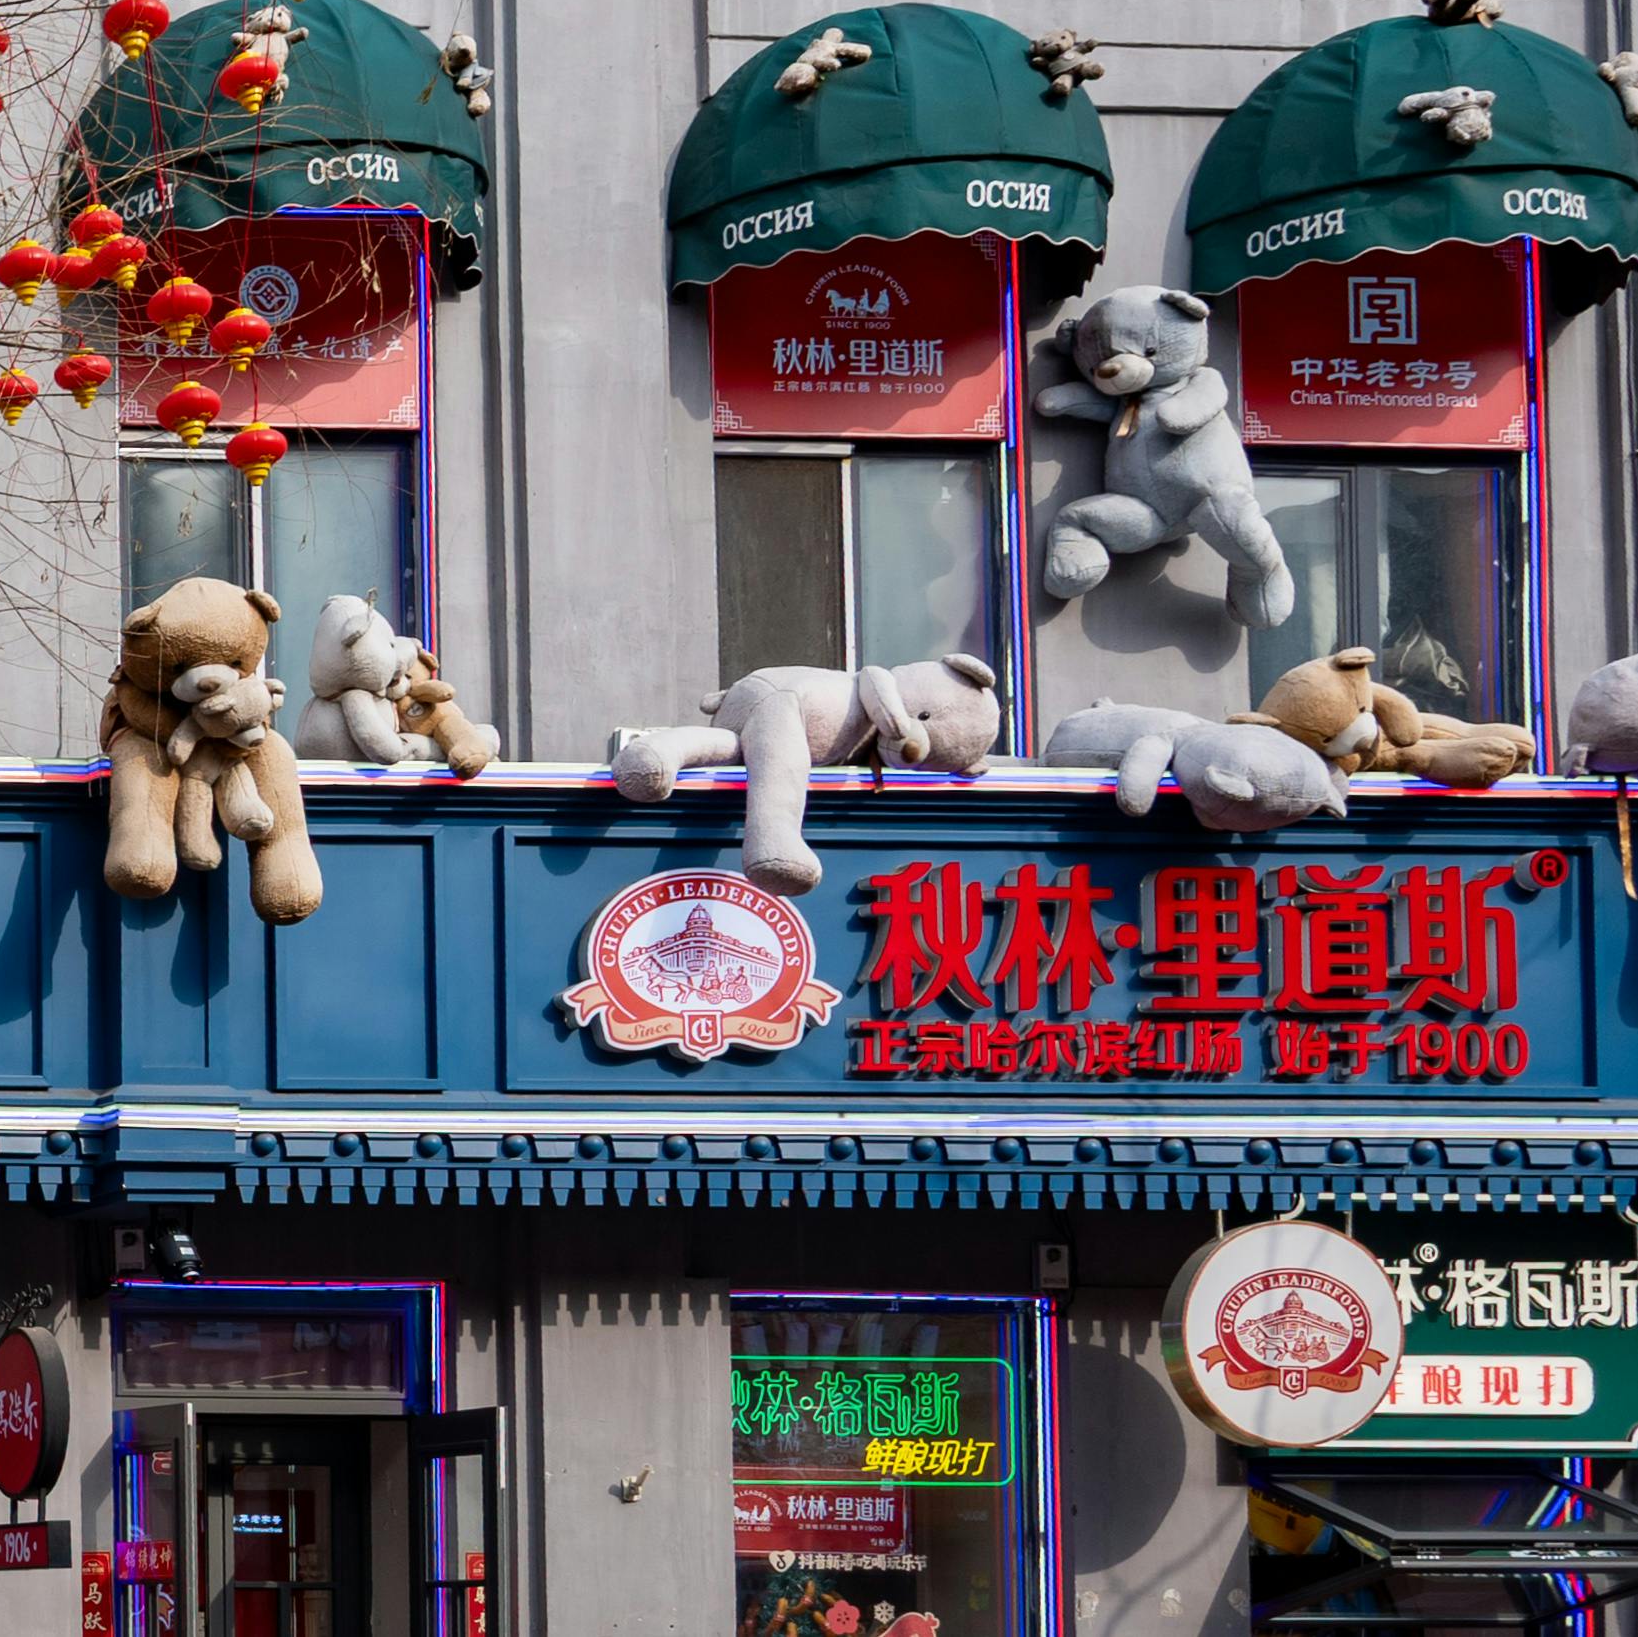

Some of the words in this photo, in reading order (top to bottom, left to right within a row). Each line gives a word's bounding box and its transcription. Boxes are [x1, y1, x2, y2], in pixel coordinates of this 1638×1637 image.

[966, 180, 1051, 212] ОССИЯ
[1503, 189, 1588, 220] ОССИЯ
[723, 201, 814, 249] ОССИЯ
[1247, 208, 1345, 257] ОССИЯ
[839, 264, 884, 278] LEADER
[884, 275, 910, 306] FOODS
[825, 321, 859, 329] SINCE
[865, 321, 890, 330] 1900
[773, 337, 944, 377] 秋林·里道斯
[1291, 357, 1477, 390] 中华老字号
[1290, 390, 1332, 406] China
[1335, 390, 1432, 408] Time-honored
[1436, 393, 1478, 408] Brand
[865, 862, 1519, 1012] 秋林·里道斯
[627, 1021, 674, 1041] Since
[737, 1021, 778, 1040] 1900
[858, 1019, 1242, 1075] 正宗哈尔滨红肠
[1275, 1019, 1529, 1075] 始于1900
[860, 1437, 996, 1477] 鲜酿现打
[787, 1495, 895, 1522] 秋林·里道斯
